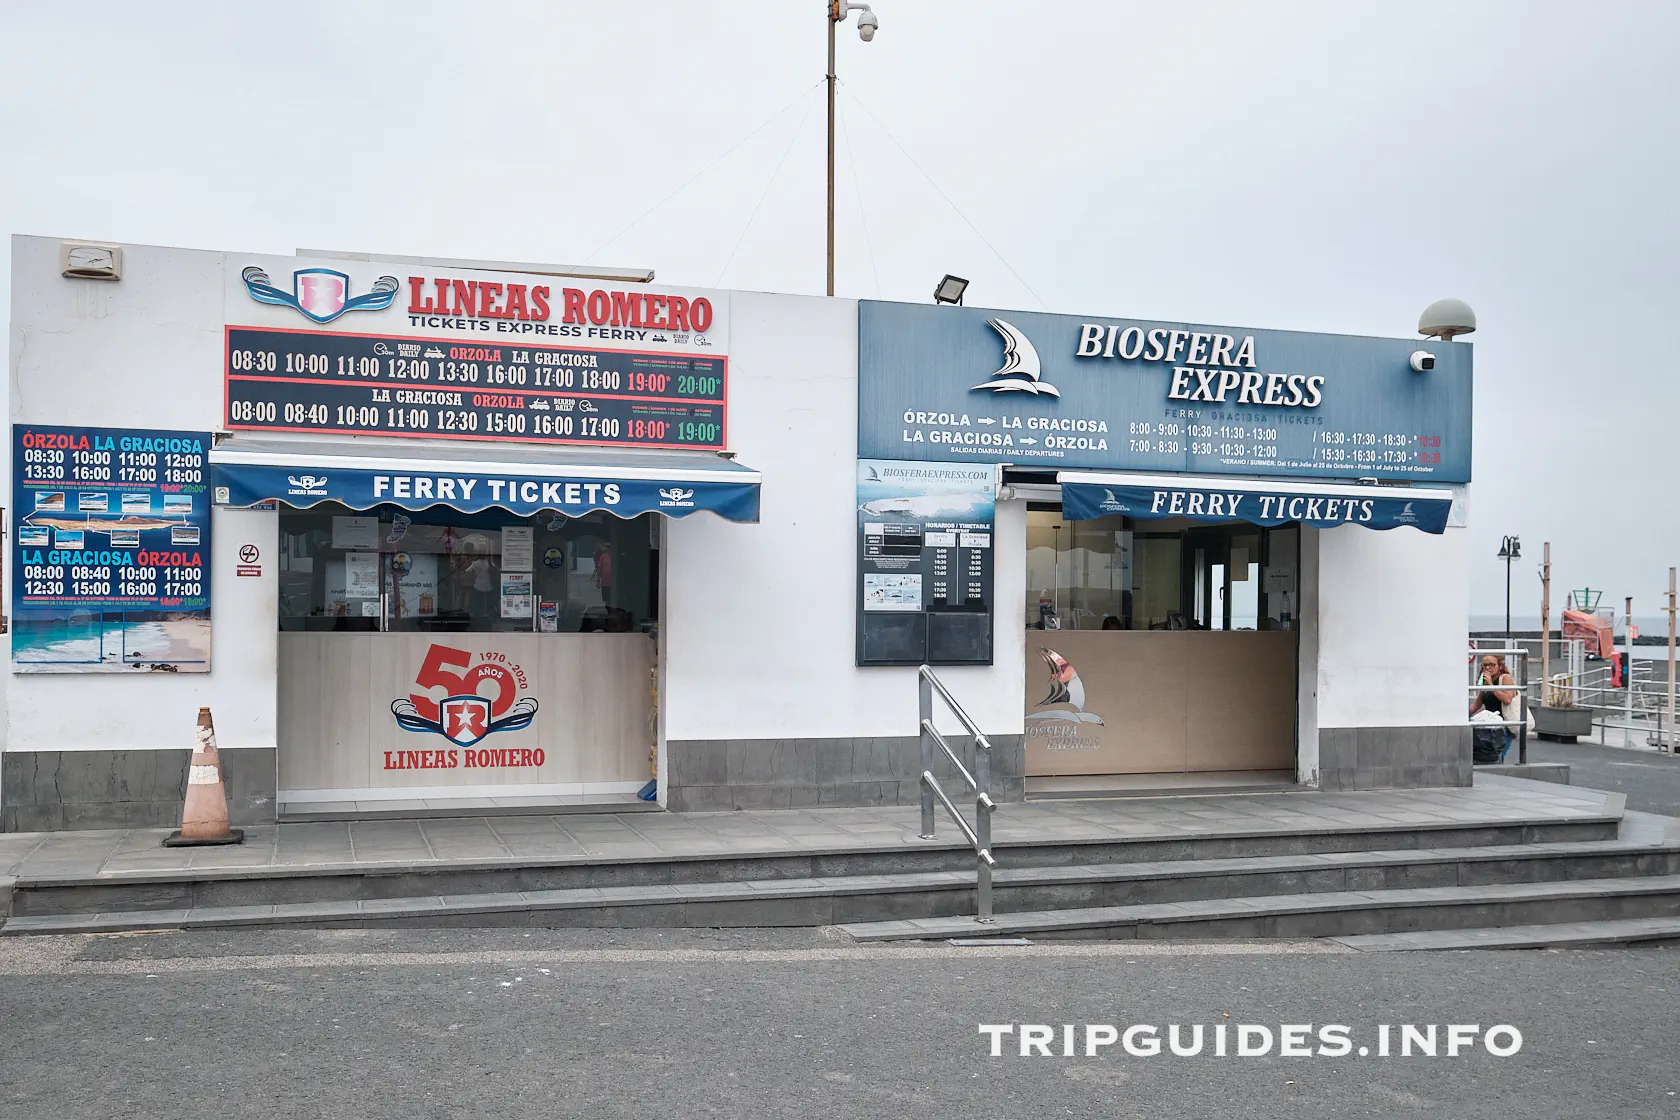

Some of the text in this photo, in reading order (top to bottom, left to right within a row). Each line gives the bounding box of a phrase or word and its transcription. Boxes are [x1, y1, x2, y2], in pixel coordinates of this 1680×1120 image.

[408, 277, 713, 332] LINEAS ROMERO
[408, 315, 647, 341] TICKETS EXPRESS FERRY
[398, 343, 421, 351] DIARIO
[1076, 323, 1257, 368] BIOSFERA
[449, 347, 598, 368] ORZOLA LA GRACIOSA
[231, 350, 277, 372] 08:30
[285, 353, 329, 374] 10:00
[337, 356, 380, 377] 11:00
[388, 358, 430, 380] 12:00
[437, 361, 479, 383] 13:30
[486, 364, 527, 385] 16:00
[534, 367, 574, 387] 17:00
[581, 370, 621, 390] 18:00
[1167, 367, 1325, 408] EXPRESS
[372, 388, 525, 409] LA GRACIOSA ORZOLA
[553, 398, 576, 406] DIARIO
[231, 400, 277, 422] 08:00
[284, 403, 328, 424] 08:40
[337, 405, 380, 426] 10:00
[387, 408, 429, 429] 11:00
[437, 410, 478, 431] 12:30
[486, 412, 526, 433] 15:00
[533, 415, 573, 436] 16:00
[581, 417, 620, 438] 17:00
[903, 408, 1109, 433] ÓRZOLA LA GRACIOSA
[1164, 409, 1323, 425] FERRY GRACIOSA TICKETS
[22, 430, 203, 454] ÓRZOLA LA GRACIOSA
[903, 430, 1108, 451] LA GRACIOSA ÓRZOLA
[1129, 422, 1150, 435] 8:00
[1158, 423, 1179, 436] 9:00
[1187, 424, 1212, 438] 10:30
[1220, 426, 1244, 439] 11:30
[1253, 427, 1277, 441] 13:00
[1321, 431, 1345, 444] 16:30
[1352, 432, 1376, 446] 17:30
[1383, 434, 1406, 446] 18:30
[24, 449, 202, 468] 08:30 10:00 11:00 12:00
[977, 447, 1003, 455] DIARIAS
[1024, 449, 1065, 458] DEPARTURES
[1129, 440, 1150, 453] 7:00
[1158, 441, 1179, 453] 8:30
[1192, 442, 1212, 455] 9:30
[1220, 443, 1244, 456] 10:30
[1253, 445, 1277, 458] 12:00
[1322, 448, 1345, 460] 15:30
[1353, 450, 1376, 462] 16:30
[1383, 451, 1406, 463] 17:30
[24, 465, 202, 483] 13:30 16:00 17:00 18:00
[883, 468, 988, 480] BIOSFERAEXPRESS.COM
[373, 475, 621, 505] FERRY TICKETS
[1150, 491, 1375, 522] FERRY TICKETS
[22, 549, 202, 566] LA GRACIOSA ÓRZOLA
[24, 566, 201, 581] 08:00 08:40 10:00 11:00
[24, 581, 201, 596] 12:30 15:00 16:00 17:00
[478, 666, 504, 679] AÑOS
[479, 652, 528, 690] 1970 2020
[383, 748, 545, 770] LINEAS ROMERO
